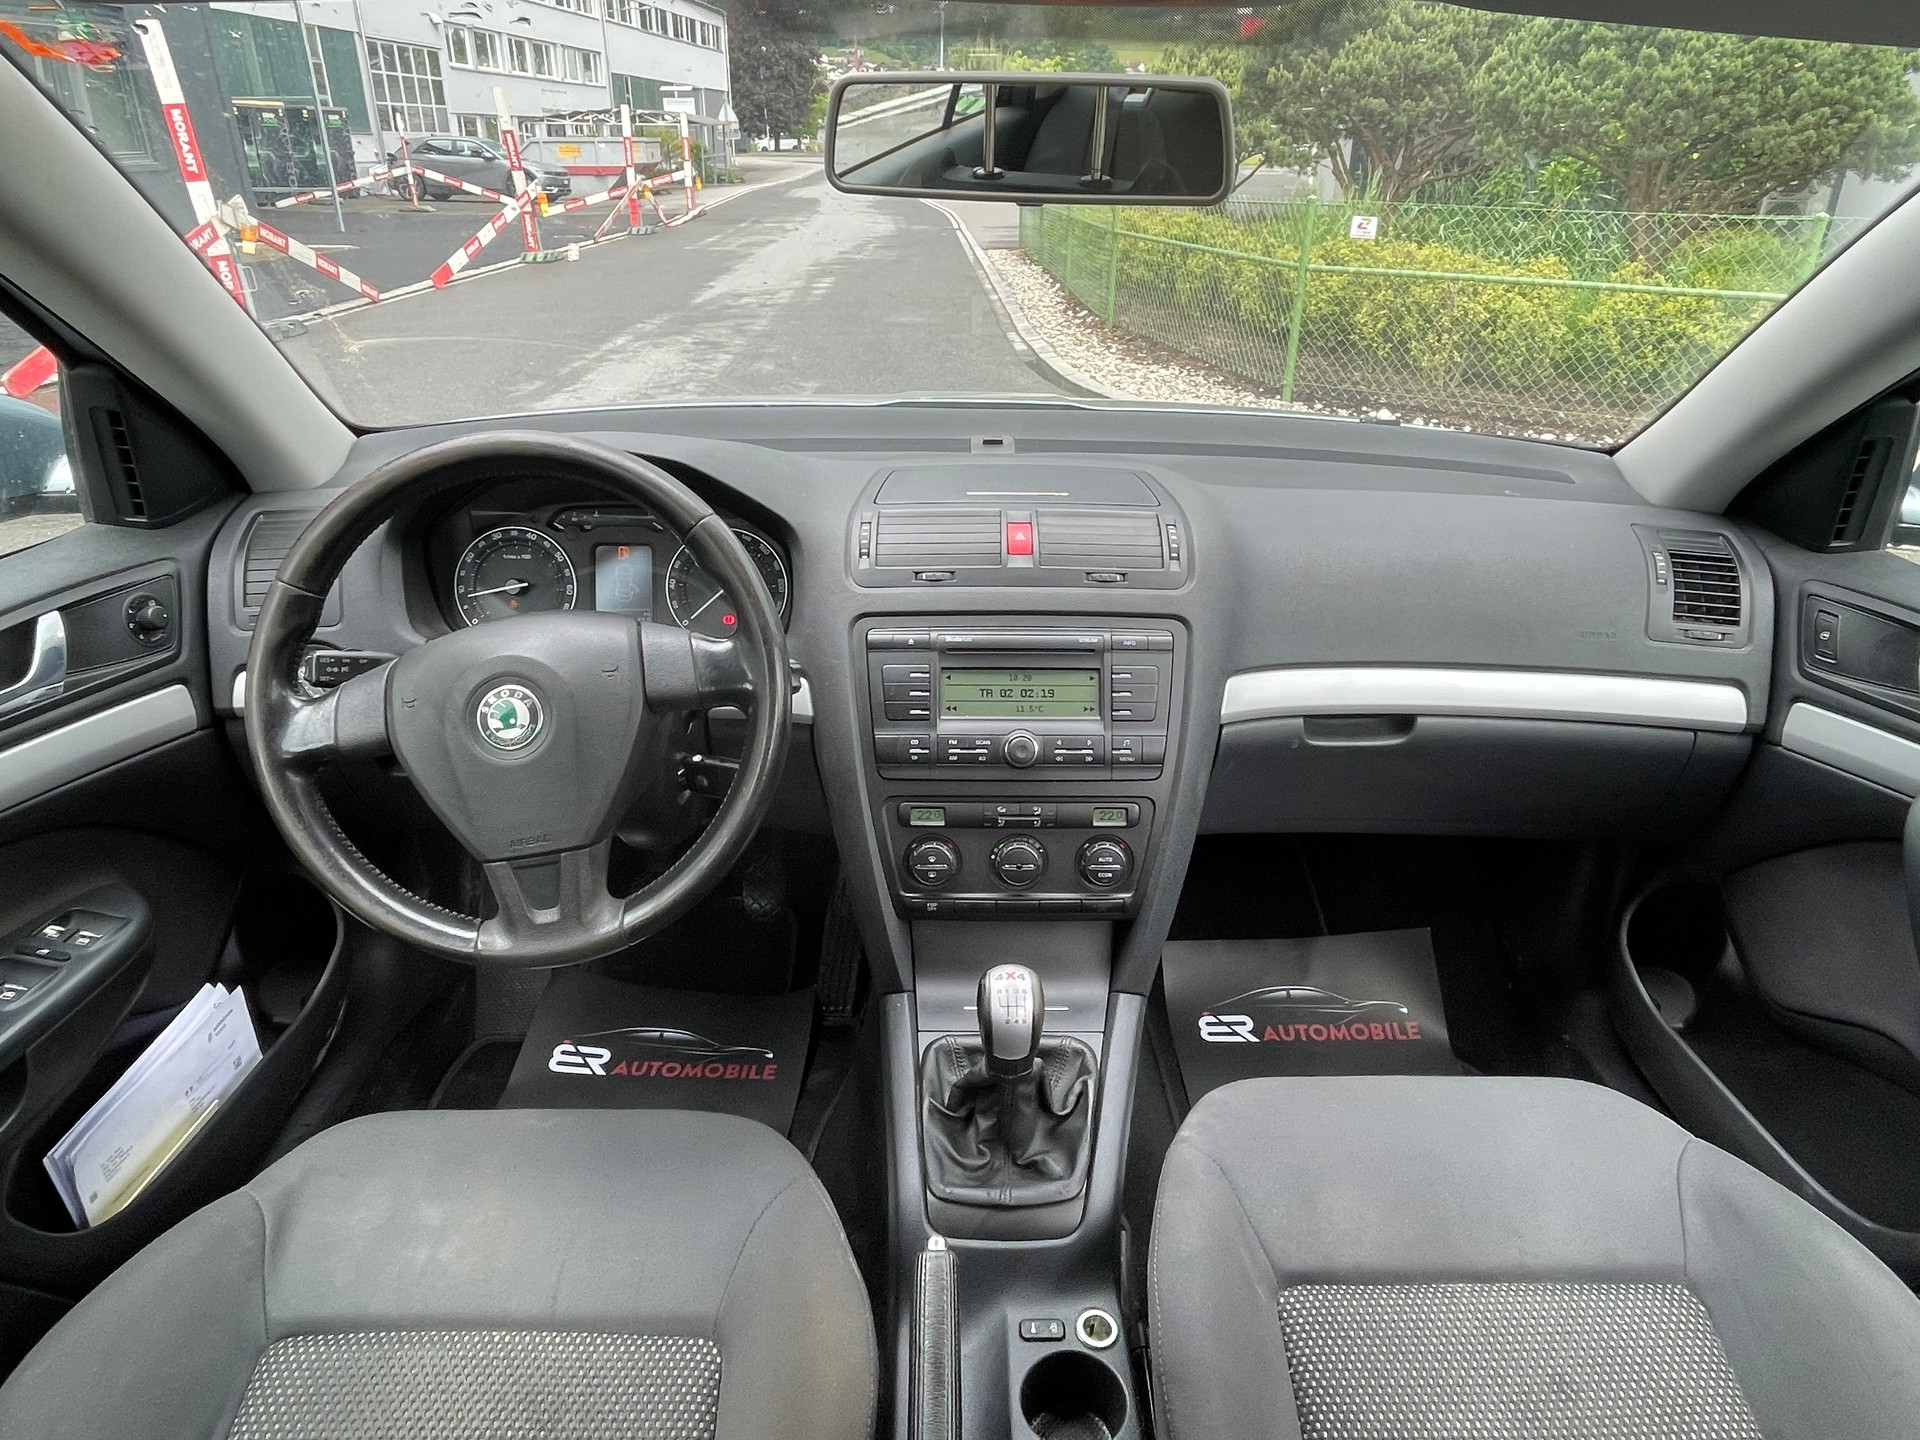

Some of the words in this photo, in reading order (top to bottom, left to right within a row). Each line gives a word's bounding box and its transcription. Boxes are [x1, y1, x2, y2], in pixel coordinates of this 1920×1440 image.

[170, 108, 200, 175] MORANT
[979, 688, 994, 698] TR
[1000, 688, 1014, 698] 02
[1020, 688, 1055, 699] 02:19
[1263, 1020, 1422, 1042] AUTOMOBILE
[610, 1060, 778, 1081] AUTOMOBILE
